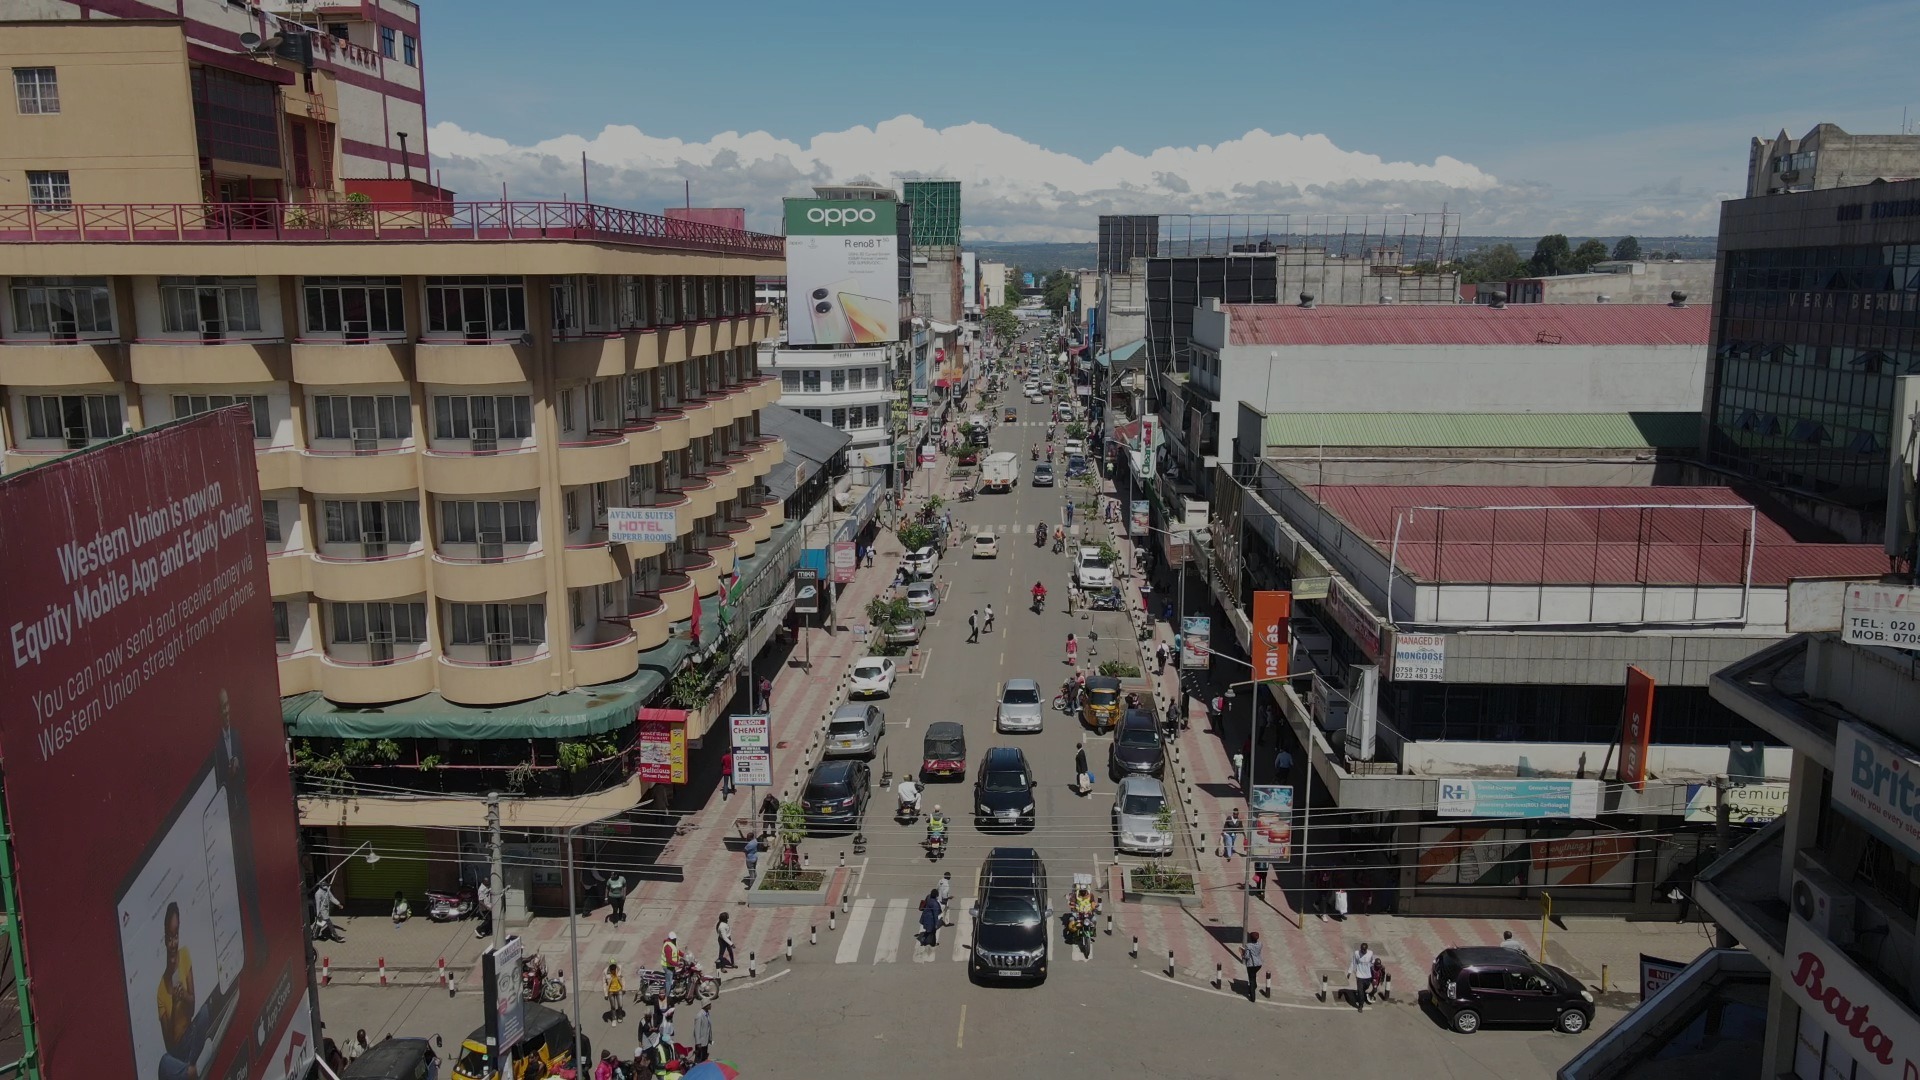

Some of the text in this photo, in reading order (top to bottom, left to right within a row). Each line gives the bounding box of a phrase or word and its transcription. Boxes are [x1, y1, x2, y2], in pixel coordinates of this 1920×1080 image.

[1789, 293, 1833, 308] VERA
[610, 511, 674, 520] AVENUE SUITES
[57, 481, 223, 584] Western Union is now on
[619, 521, 663, 531] HOTEL
[644, 533, 672, 541] ROOMS
[10, 495, 255, 668] Equity Mobile App and Equity Online!
[1851, 618, 1915, 631] TEL: 020
[32, 552, 253, 724] You can now send and receive money via
[1397, 636, 1444, 645] MANAGED BY
[1852, 630, 1888, 641] MOB:
[1259, 624, 1279, 676] naivas
[1397, 651, 1443, 661] MONGOOSE
[38, 581, 255, 761] Western Union straight from your phone.
[1730, 788, 1789, 800] remiu
[1850, 787, 1867, 804] With
[1868, 800, 1881, 814] you
[1883, 809, 1904, 828] every
[1791, 951, 1894, 1065] Bata
